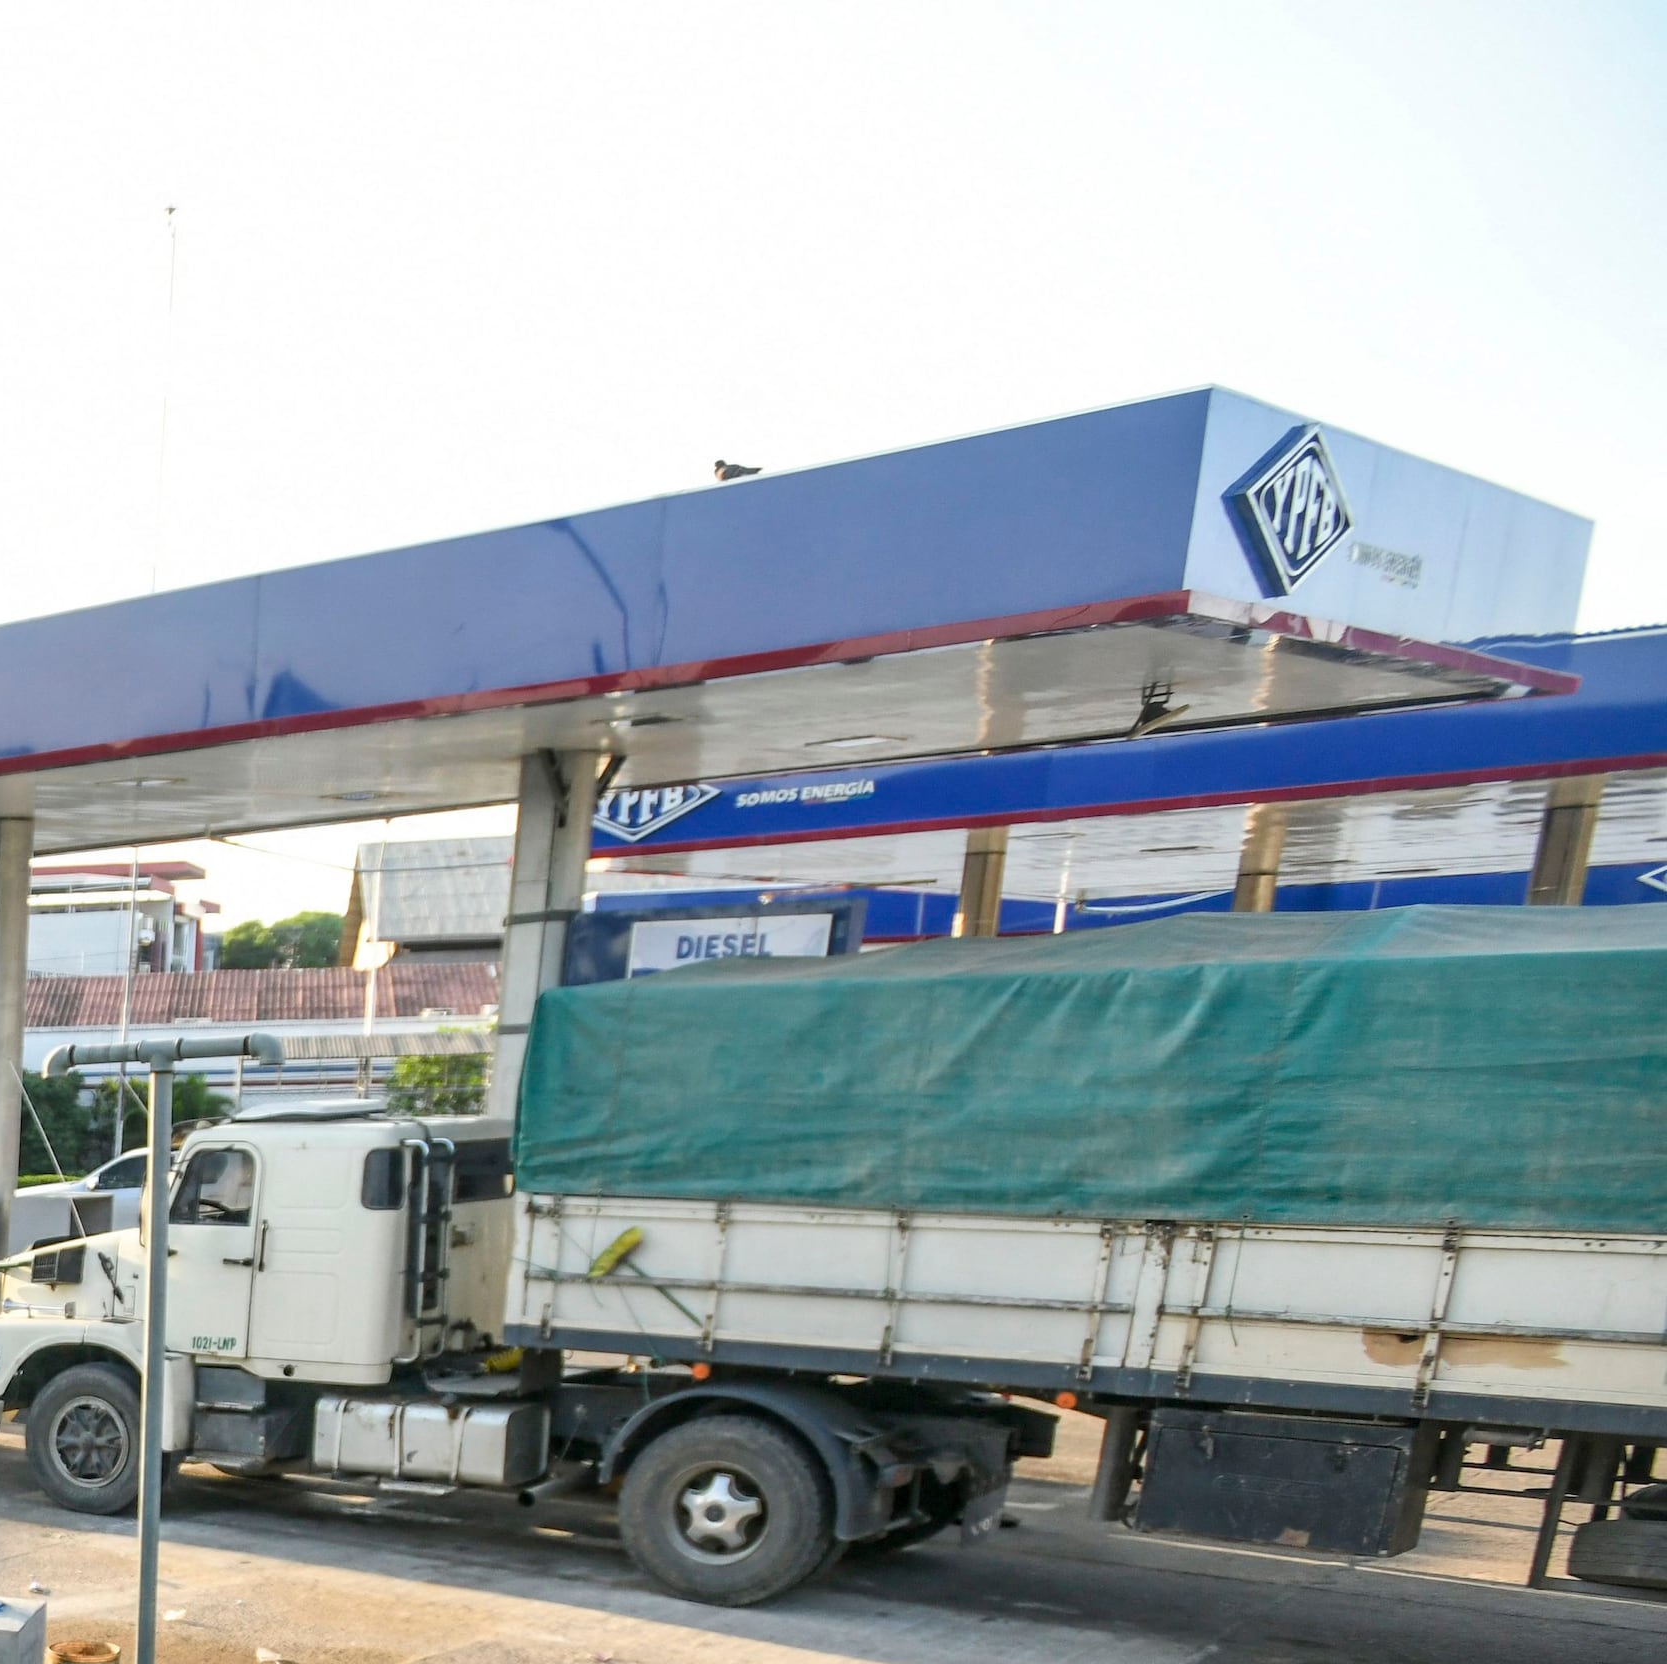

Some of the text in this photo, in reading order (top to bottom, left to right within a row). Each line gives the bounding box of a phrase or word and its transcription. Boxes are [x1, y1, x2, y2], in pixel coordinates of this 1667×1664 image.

[1272, 455, 1338, 561] YPFB
[736, 779, 875, 808] SOMOS ENERGÍA
[676, 933, 772, 960] DIESEL
